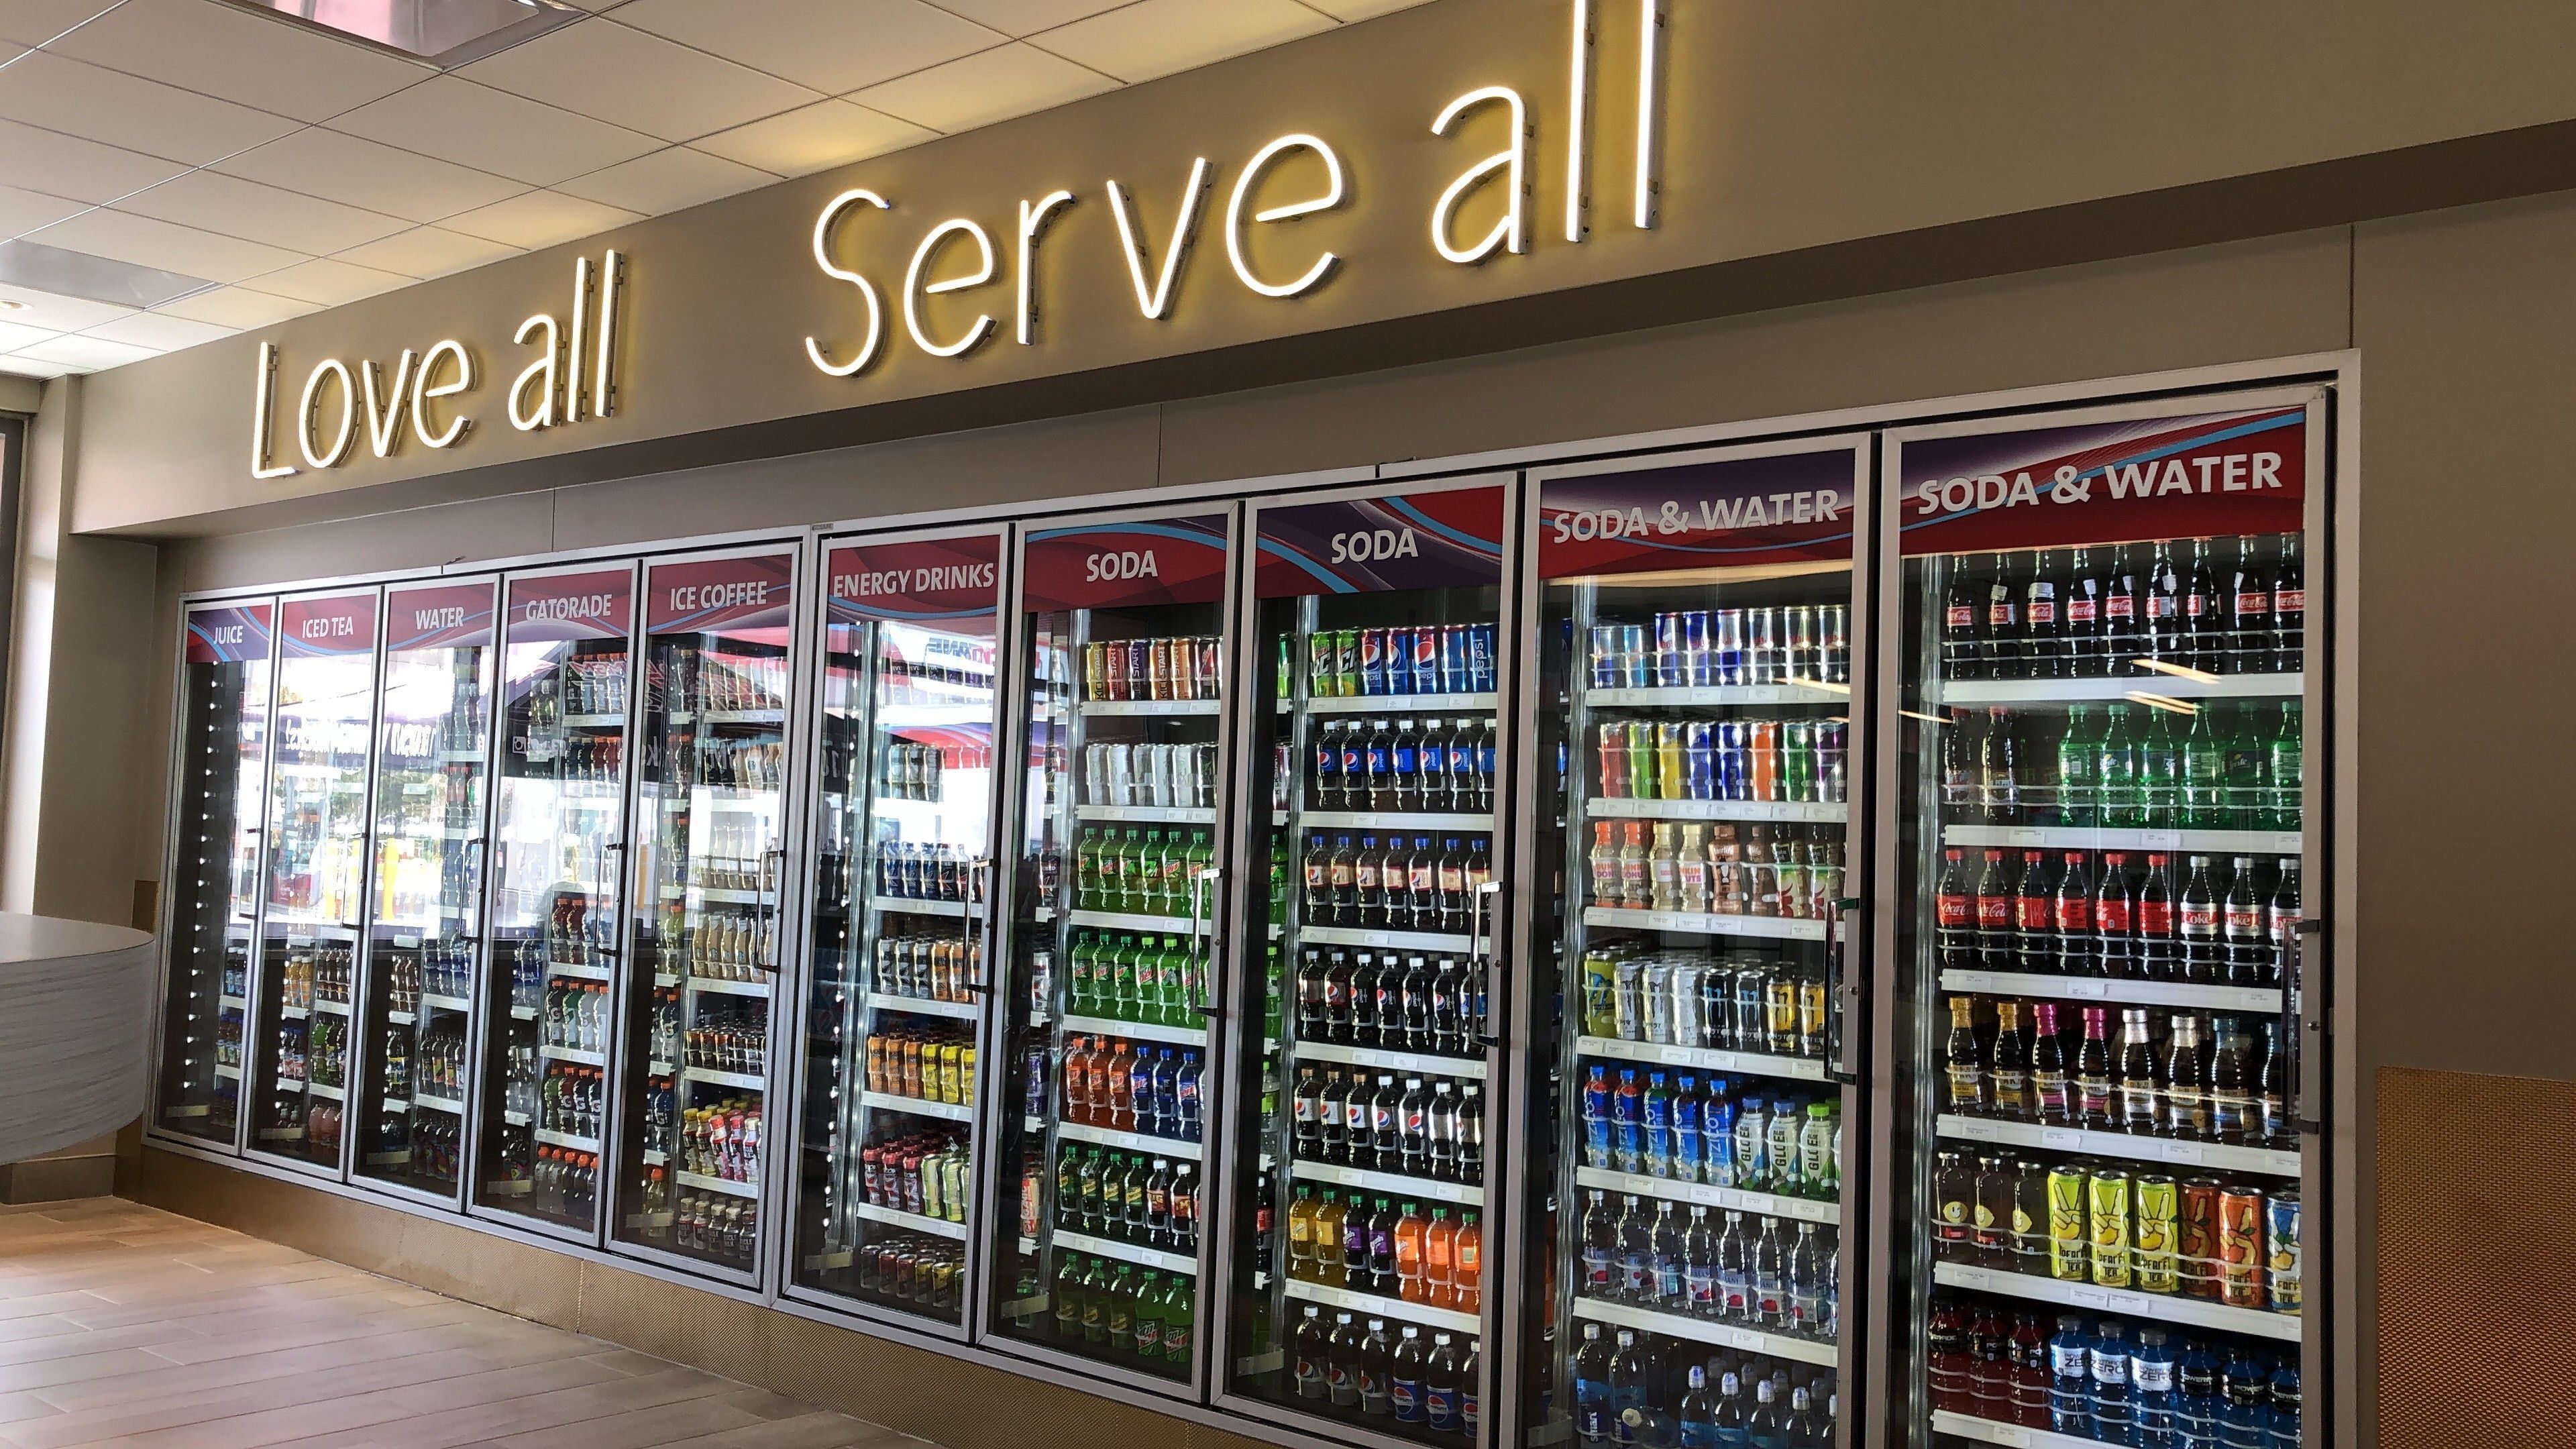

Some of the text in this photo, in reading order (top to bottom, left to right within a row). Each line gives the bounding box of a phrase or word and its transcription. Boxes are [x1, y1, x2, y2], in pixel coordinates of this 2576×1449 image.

[806, 0, 1658, 377] Serve all
[252, 249, 616, 479] Love all
[1918, 451, 2282, 514] SODA & WATER
[1554, 488, 1839, 544] SODA & WATER
[1331, 528, 1419, 564] SODA
[833, 562, 994, 598] ENERGY DRINKS
[1086, 550, 1158, 582] SODA
[525, 594, 612, 622] GATORADE
[670, 580, 767, 611] ICE COFFEE
[213, 625, 244, 645] JUICE
[302, 616, 354, 639] ICED TEA
[415, 606, 465, 630] WATER
[1474, 639, 1489, 678] pepsi
